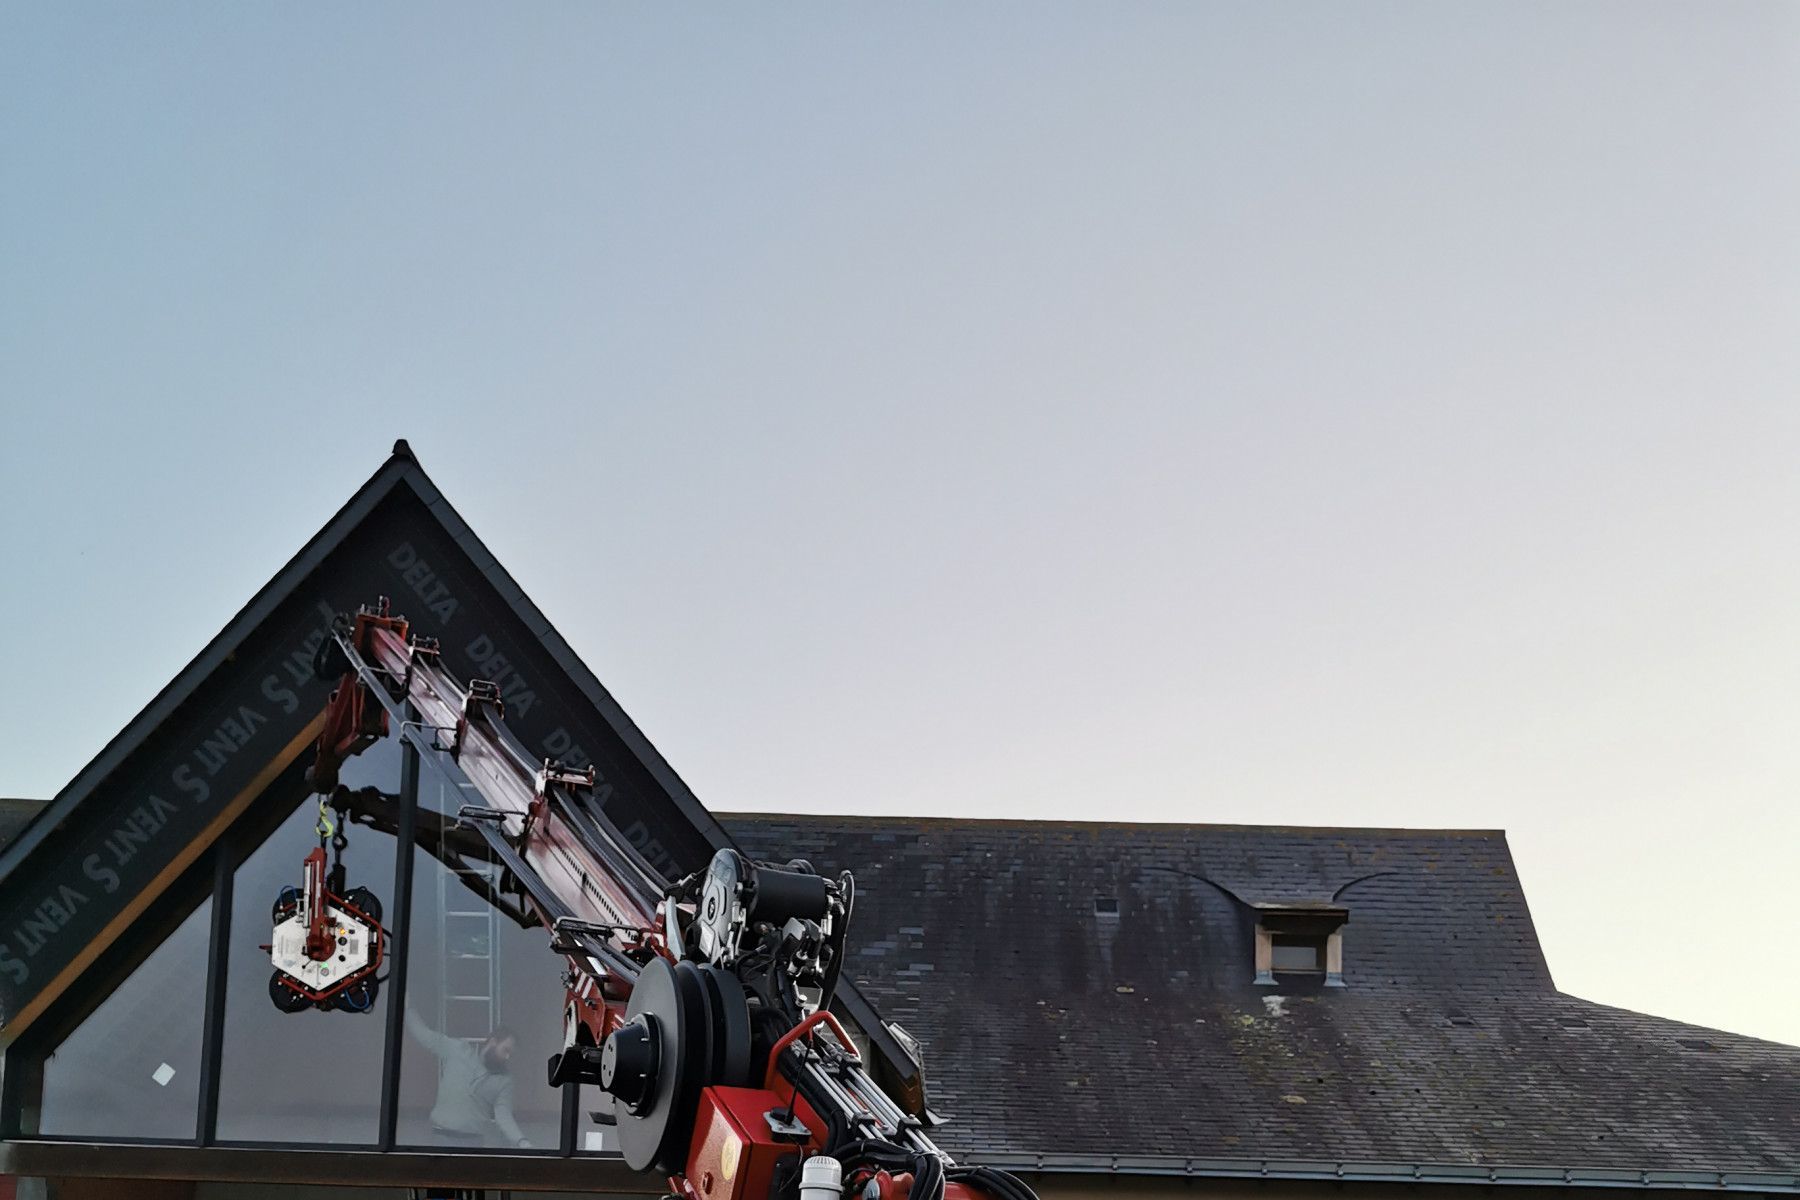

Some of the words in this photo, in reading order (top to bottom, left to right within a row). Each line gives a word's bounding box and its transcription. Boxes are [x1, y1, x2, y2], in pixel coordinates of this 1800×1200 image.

[387, 541, 459, 625] DELTA
[261, 673, 299, 714] S
[465, 634, 539, 719] DELTA
[194, 705, 268, 775] VENT
[172, 763, 210, 803] S
[104, 794, 178, 868] VENT
[82, 853, 120, 893] S
[13, 884, 91, 957] VENT
